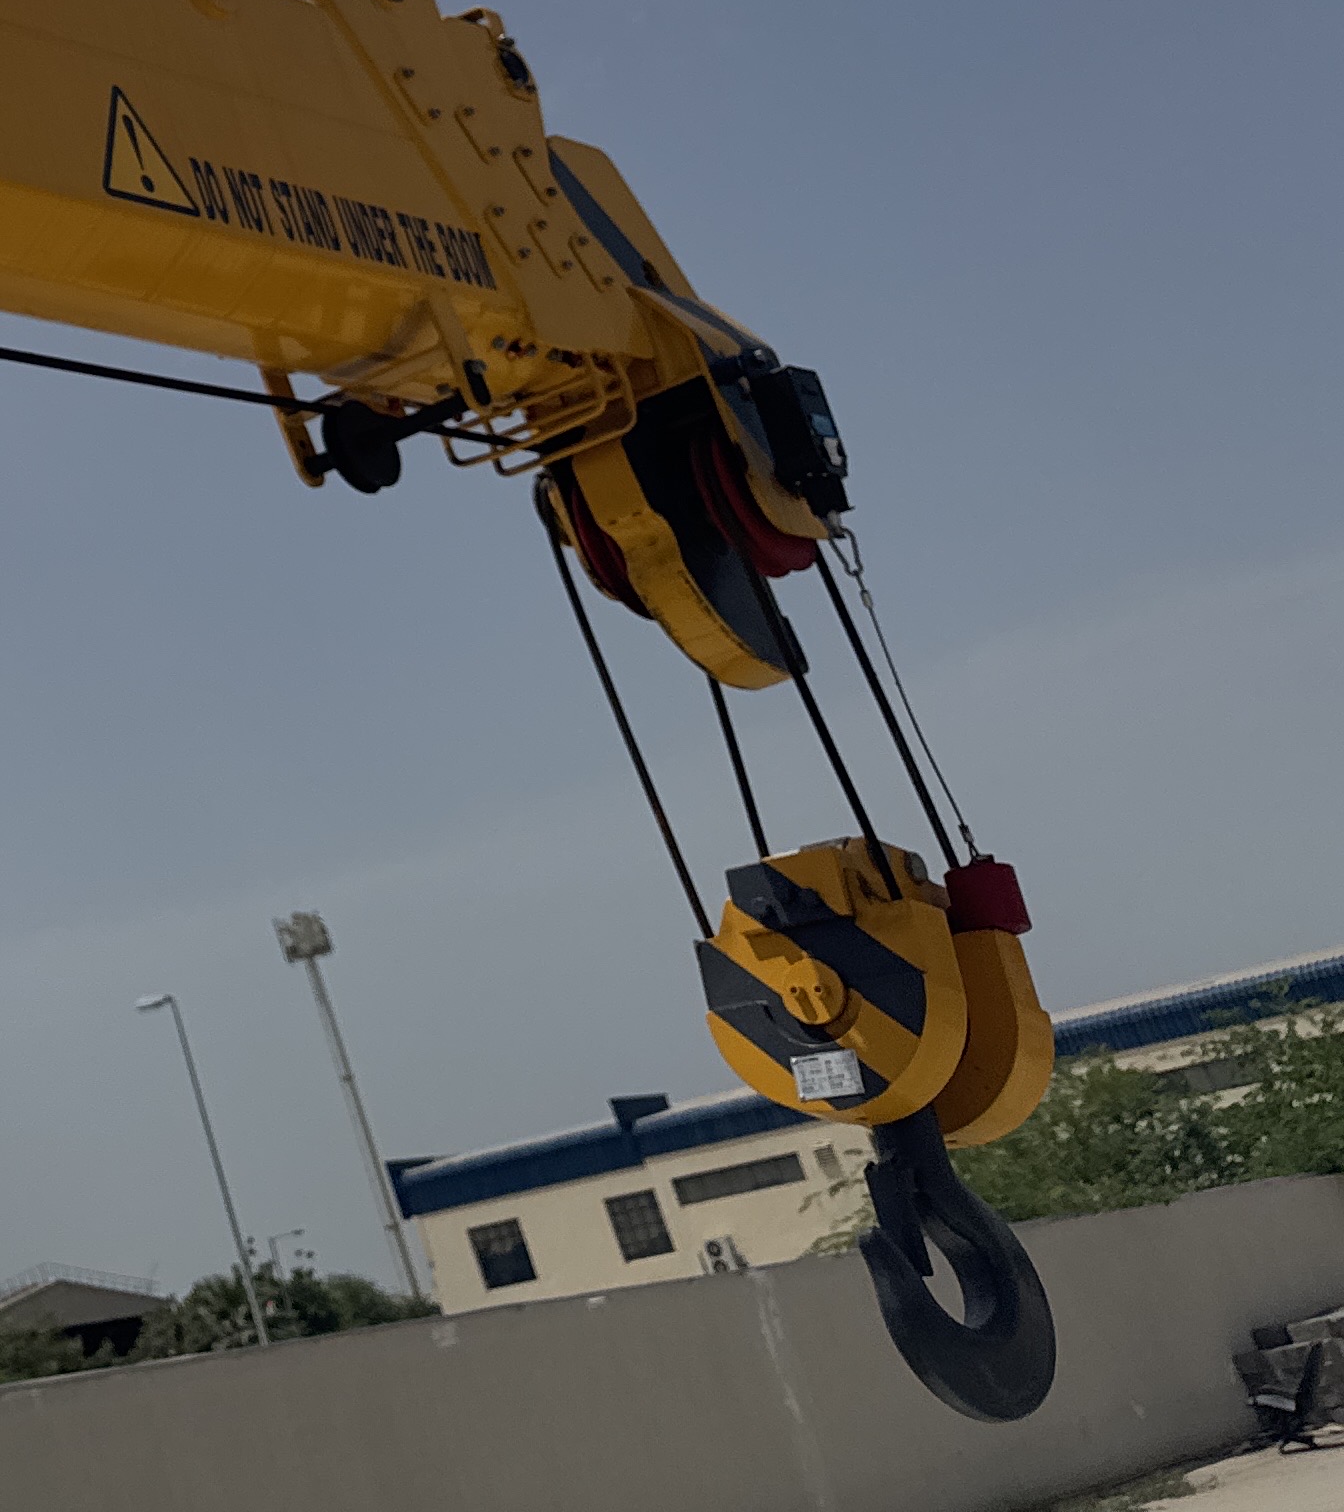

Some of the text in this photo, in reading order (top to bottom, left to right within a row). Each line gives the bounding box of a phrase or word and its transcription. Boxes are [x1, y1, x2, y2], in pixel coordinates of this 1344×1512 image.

[189, 156, 497, 290] DO NOT STAND UNDER THE BOOM
